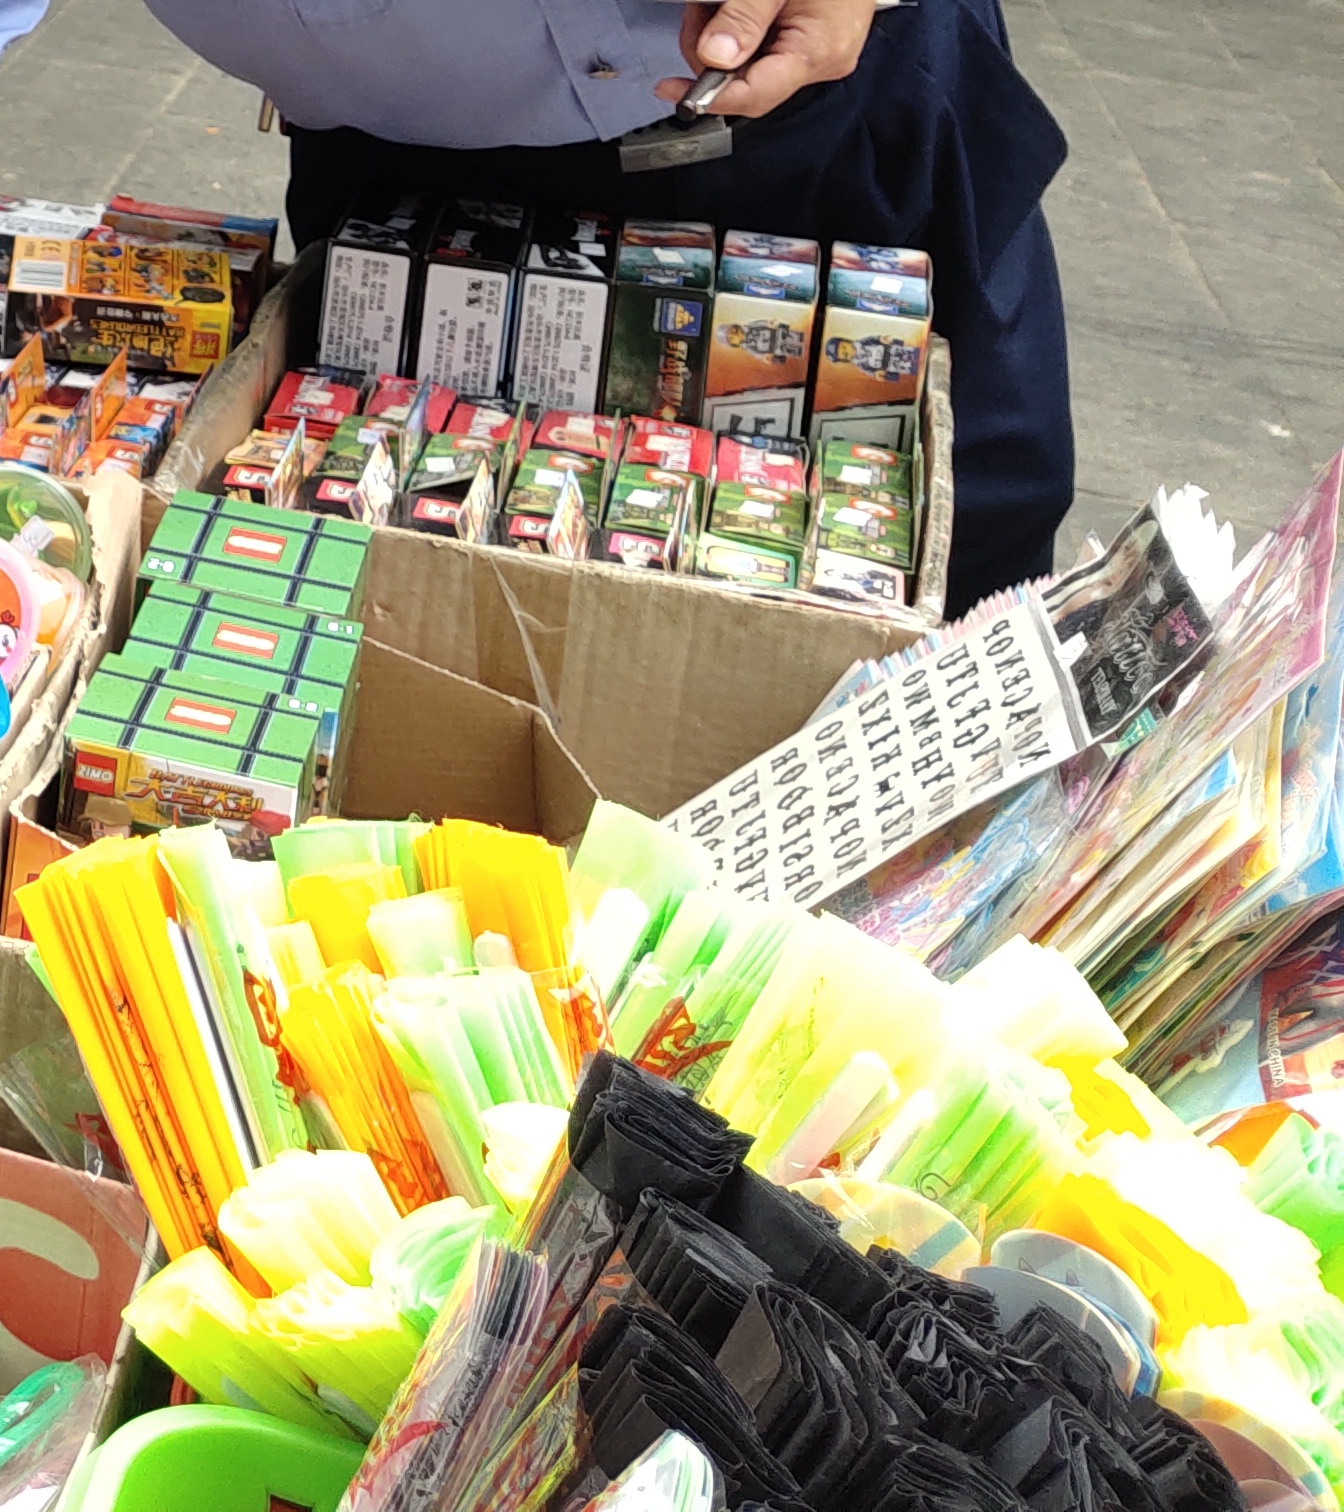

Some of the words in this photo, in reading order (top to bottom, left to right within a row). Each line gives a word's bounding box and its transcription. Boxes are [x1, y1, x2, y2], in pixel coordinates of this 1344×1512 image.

[75, 764, 115, 783] ZIMO
[125, 778, 264, 812] 大吉大利
